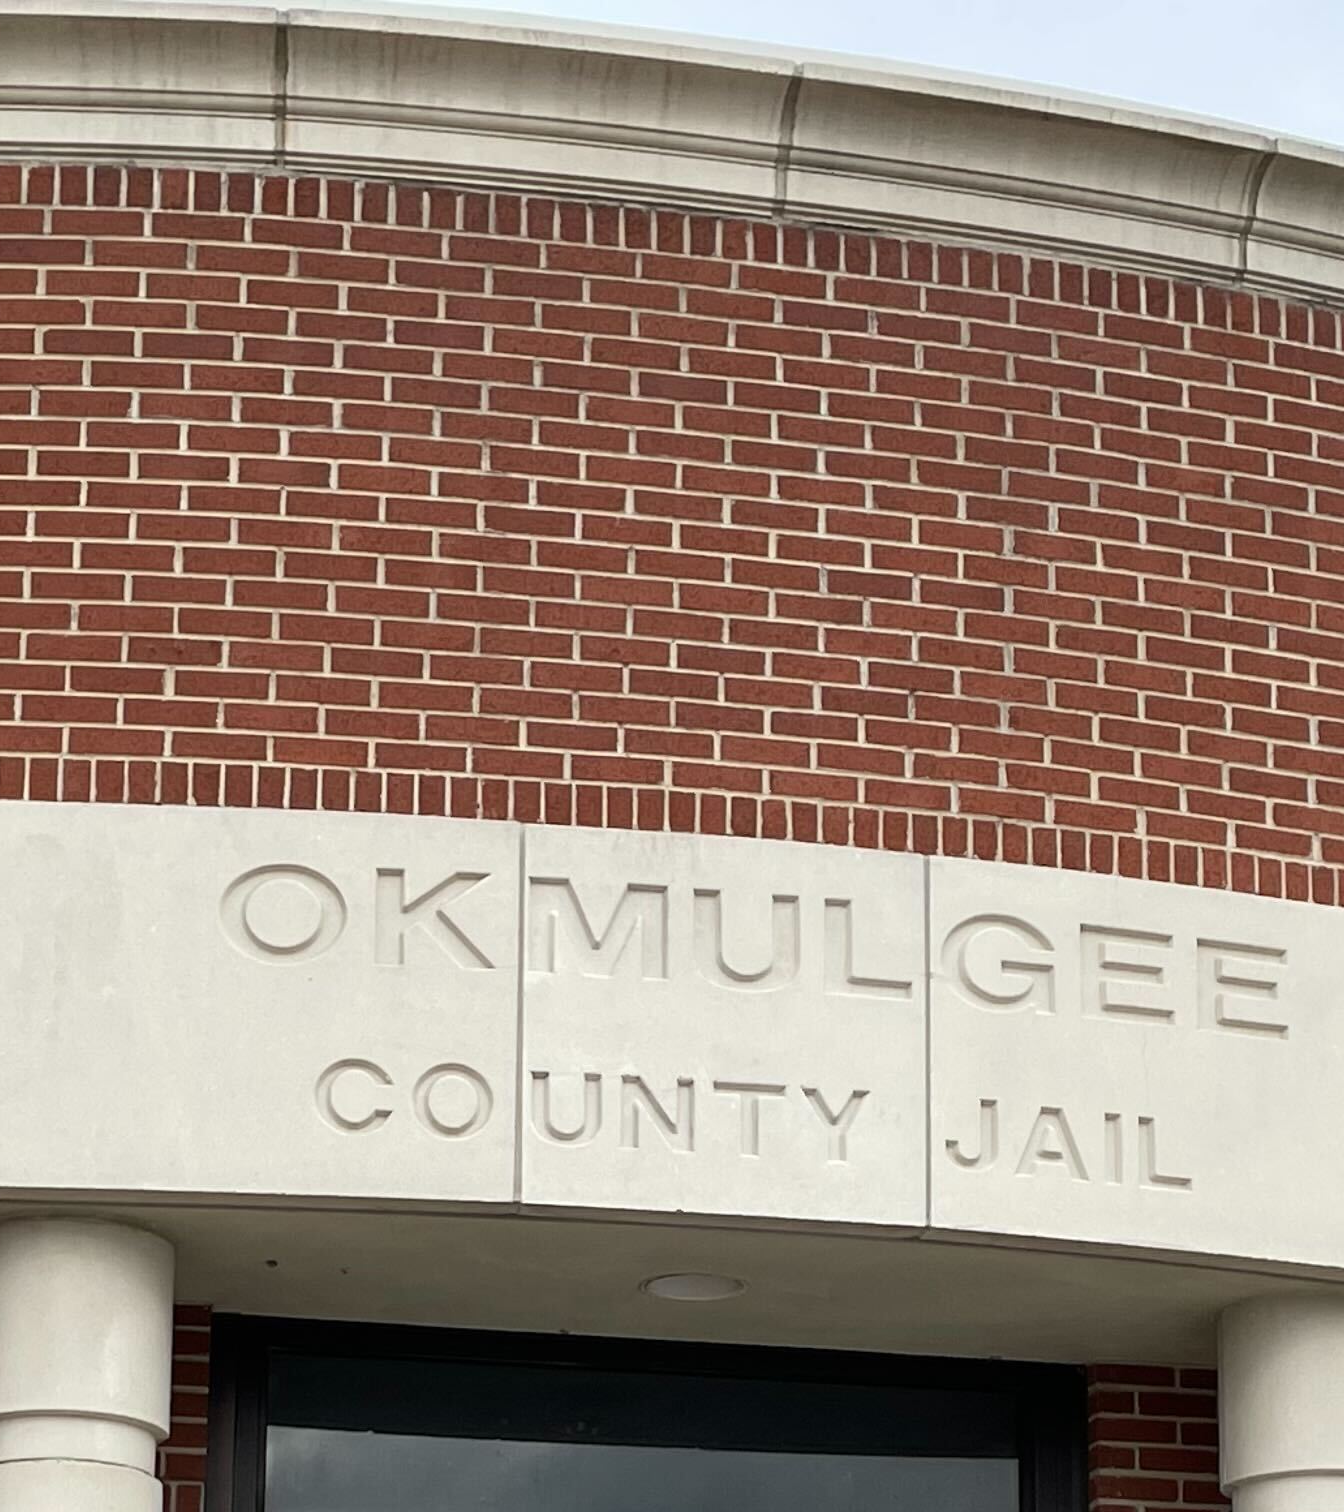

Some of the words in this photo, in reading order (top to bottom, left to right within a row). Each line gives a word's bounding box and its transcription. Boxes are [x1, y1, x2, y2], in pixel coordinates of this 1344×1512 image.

[219, 863, 1289, 1040] OKMULGEE
[315, 1057, 871, 1164] COUNTY
[945, 1098, 1193, 1191] JAIL
